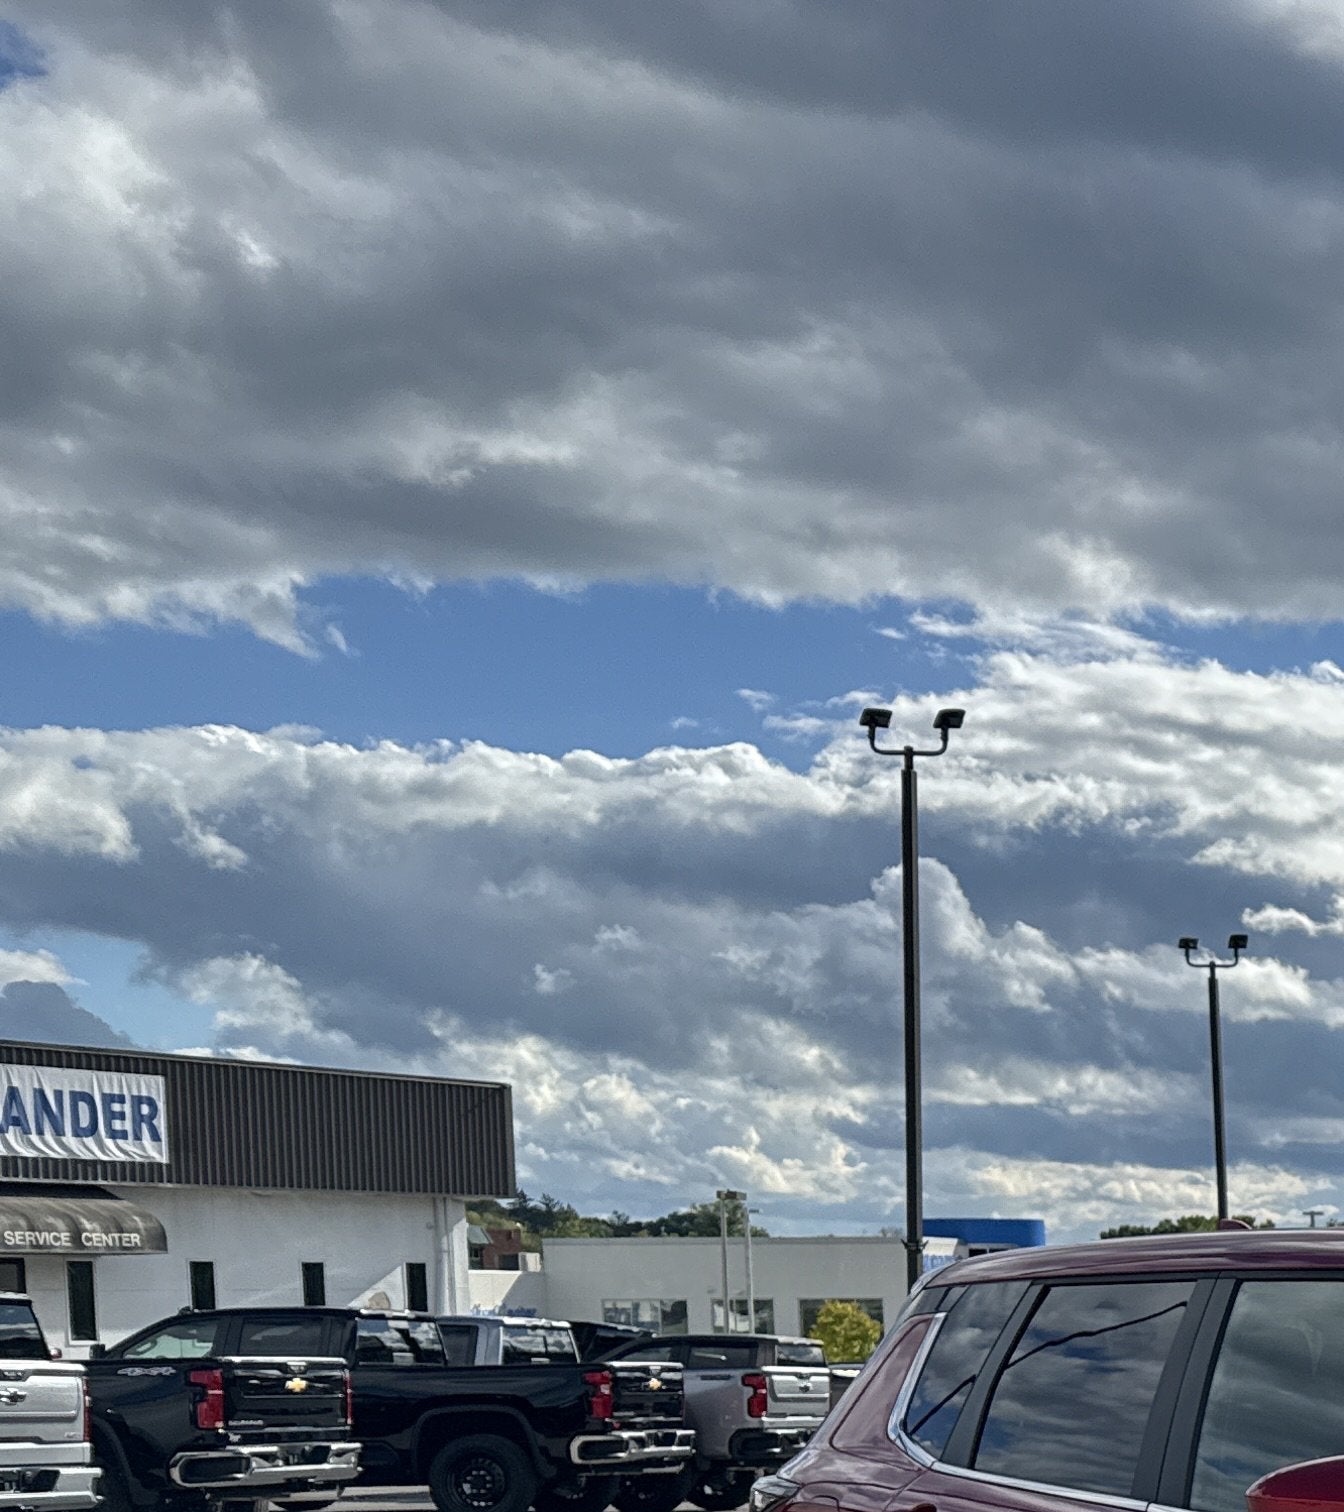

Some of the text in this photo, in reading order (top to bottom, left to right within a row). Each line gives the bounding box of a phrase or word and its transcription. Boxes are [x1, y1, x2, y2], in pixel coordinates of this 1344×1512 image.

[0, 1085, 162, 1143] ANDER
[3, 1230, 142, 1248] SERVICE CENTER
